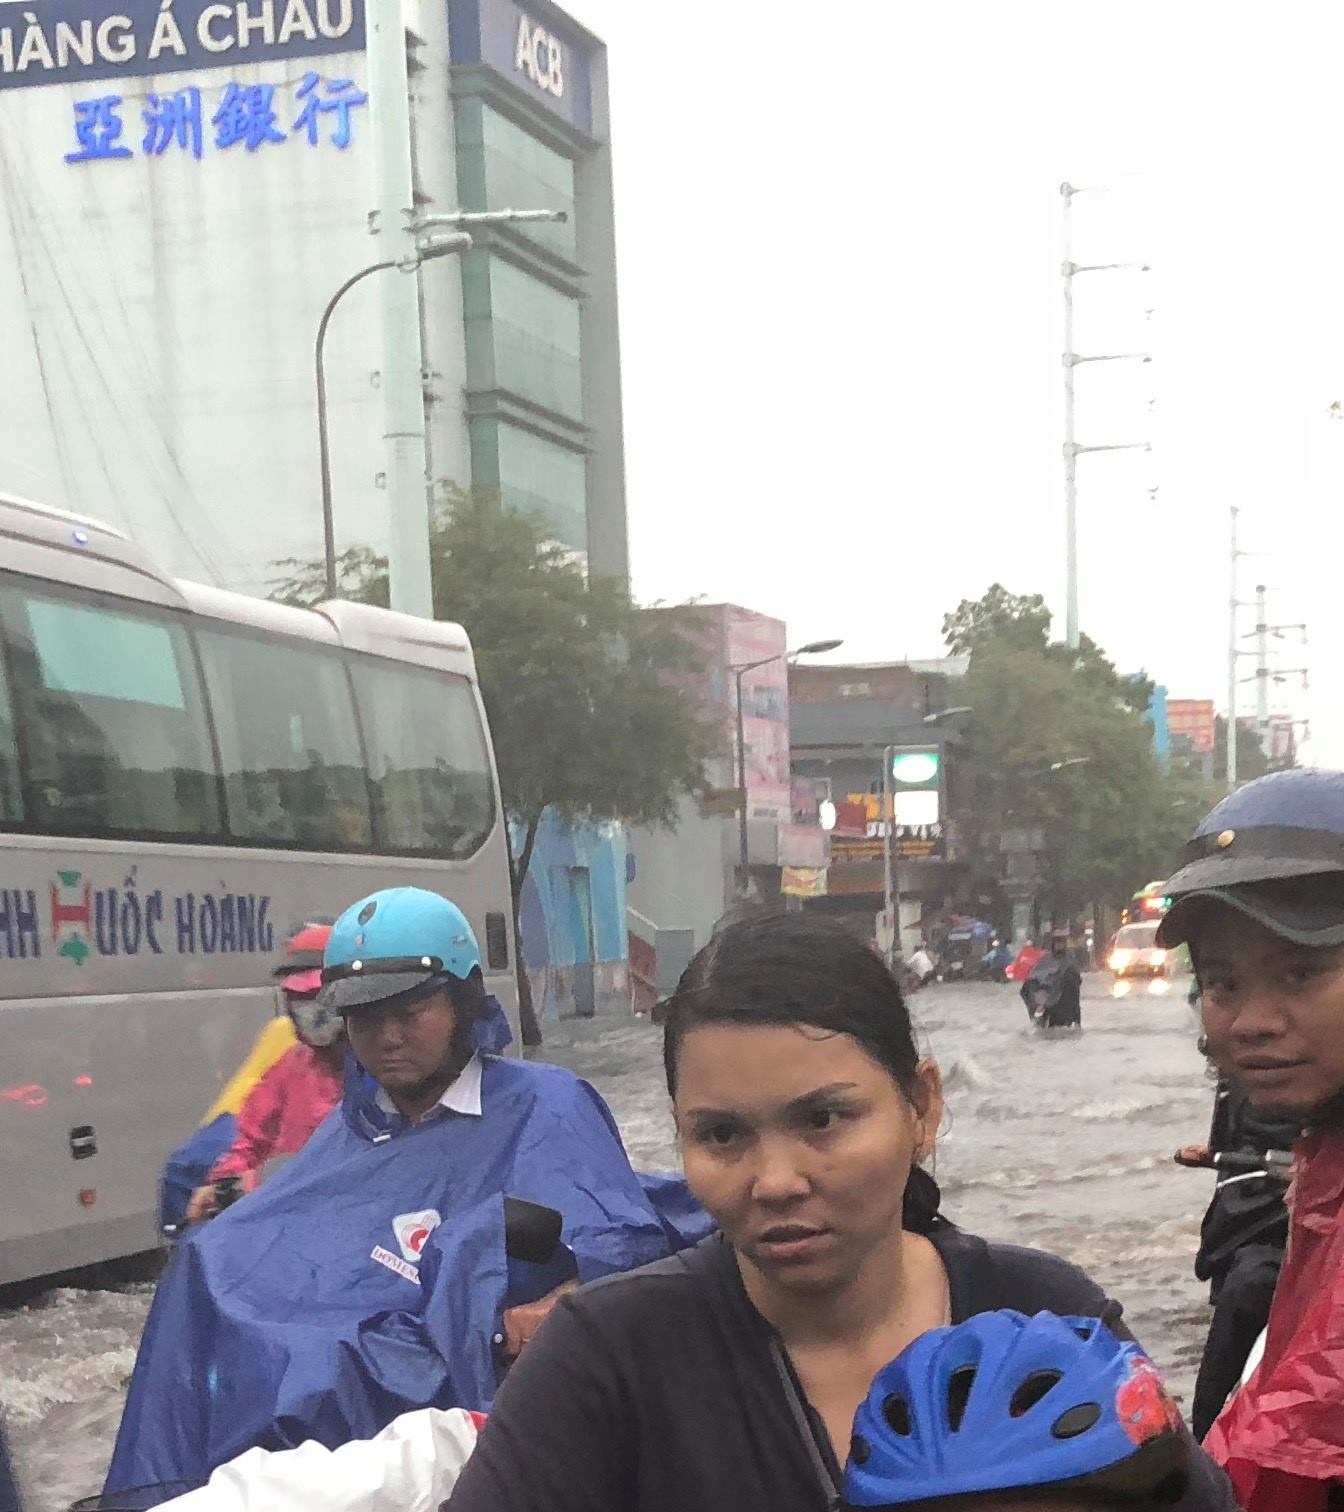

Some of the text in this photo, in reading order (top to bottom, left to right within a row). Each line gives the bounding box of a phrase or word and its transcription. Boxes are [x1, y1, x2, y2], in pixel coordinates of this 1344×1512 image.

[516, 14, 563, 97] ACB
[63, 71, 369, 164] 亞洲銀行
[176, 880, 273, 953] HOÀNG
